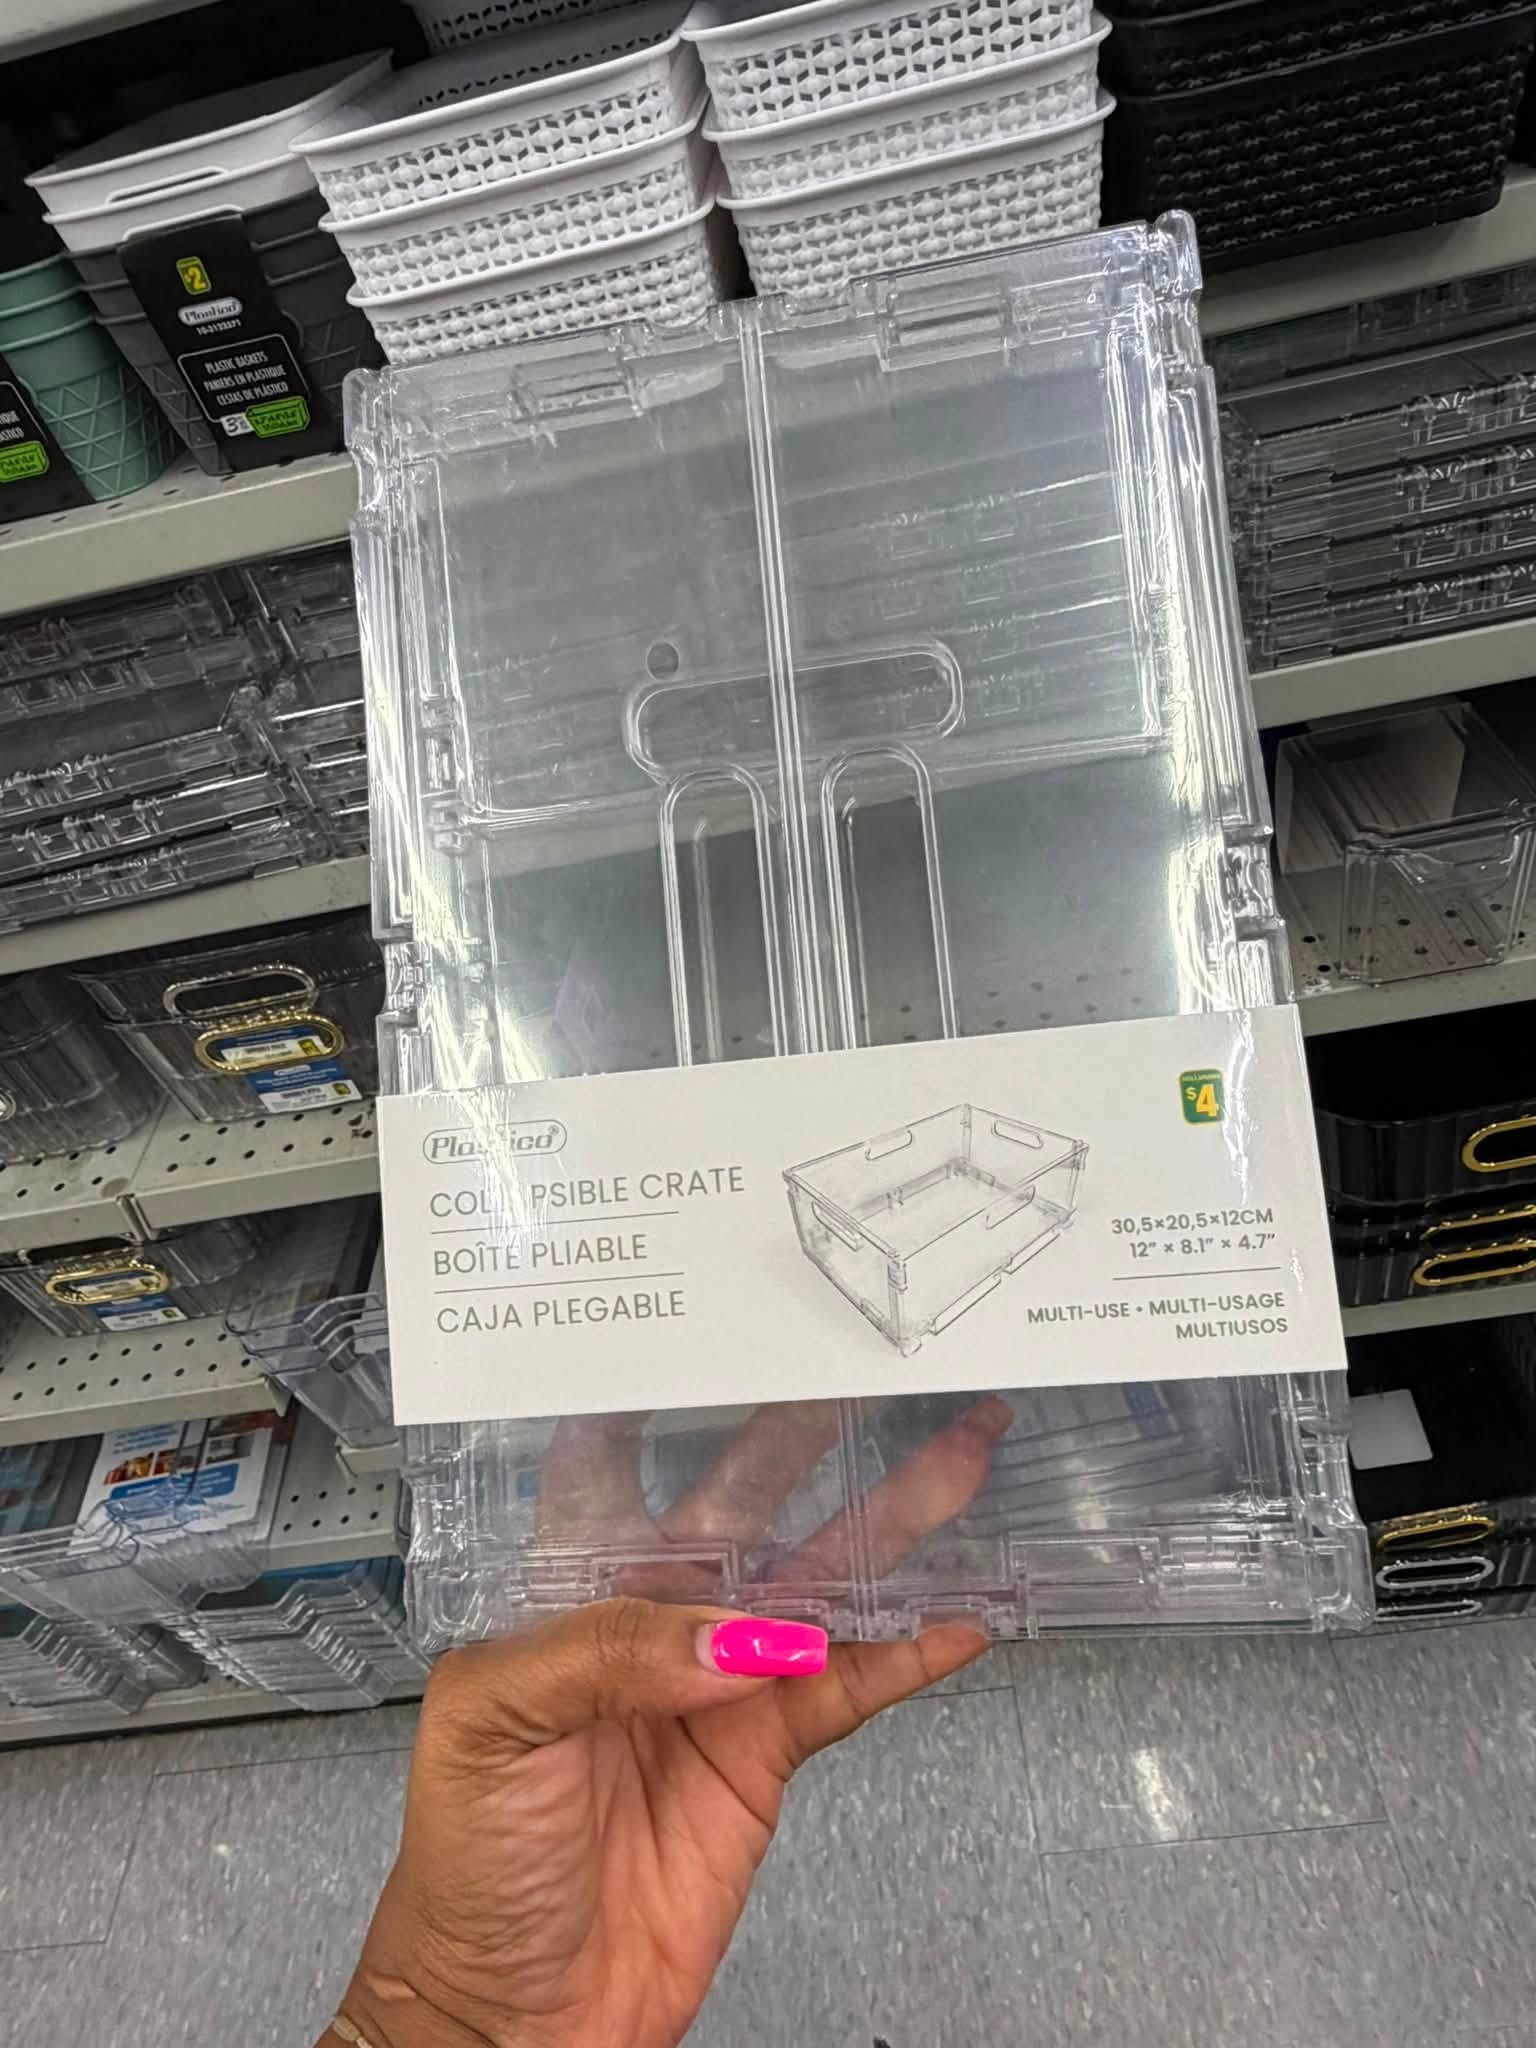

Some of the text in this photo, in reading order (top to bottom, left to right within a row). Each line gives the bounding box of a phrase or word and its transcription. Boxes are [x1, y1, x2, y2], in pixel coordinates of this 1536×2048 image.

[203, 364, 286, 392] PANIERS EN PLASTIQUE
[204, 351, 268, 374] PLASTIC BASKETS
[216, 381, 288, 406] CESTAS DE PLÁSTICO
[1185, 1083, 1220, 1117] $4
[430, 1166, 745, 1217] COLPSIBLE CRATE
[434, 1234, 647, 1275] BOÎTE PLIABLE
[437, 1290, 686, 1333] CAJA PLEGABLE
[1027, 1292, 1286, 1323] MULTI-USE MULTI-USAGE
[1175, 1318, 1288, 1339] MULTIUSOS
